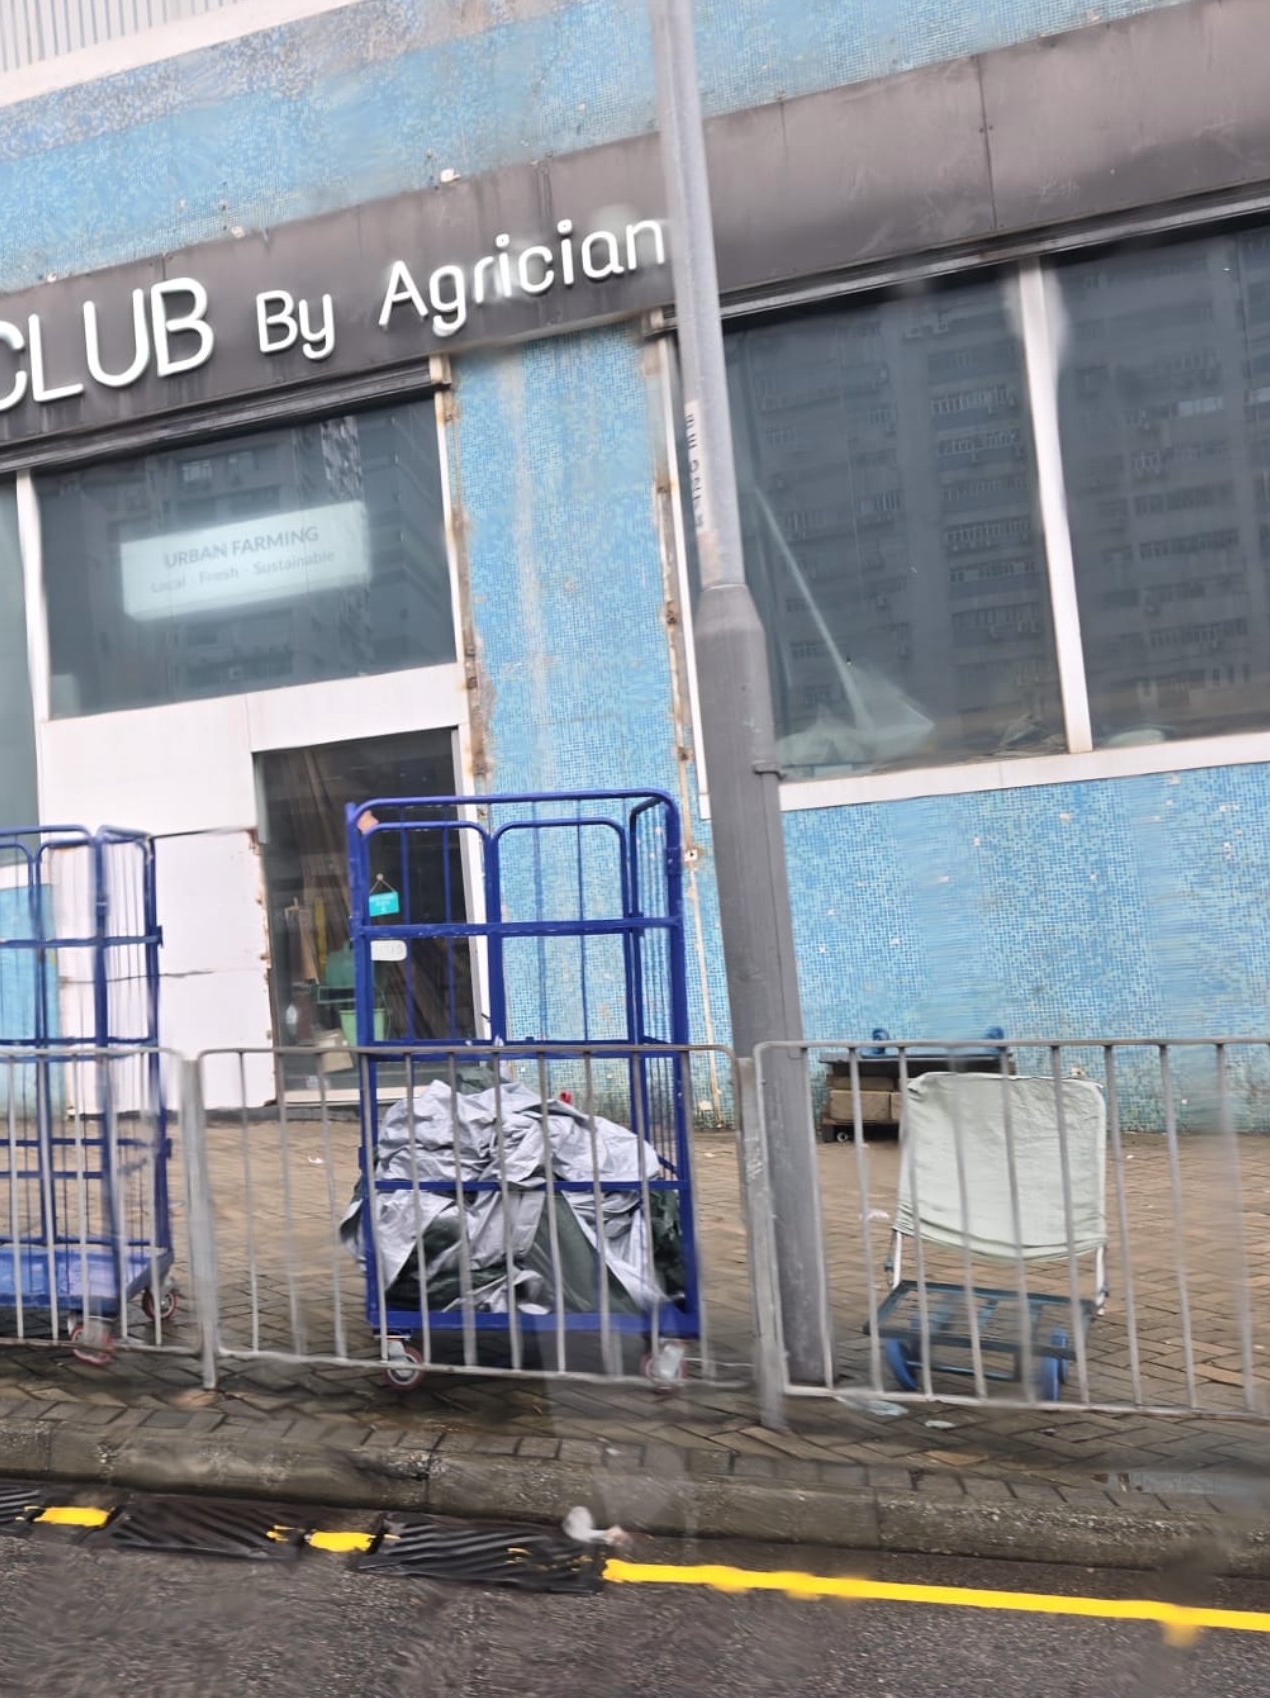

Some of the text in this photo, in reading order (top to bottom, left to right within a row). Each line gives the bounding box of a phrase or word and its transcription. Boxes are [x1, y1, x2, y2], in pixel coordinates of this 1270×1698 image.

[256, 289, 336, 361] By
[378, 218, 668, 337] Agrician
[163, 526, 320, 569] URBAN FARMING
[252, 550, 335, 576] Sustainable
